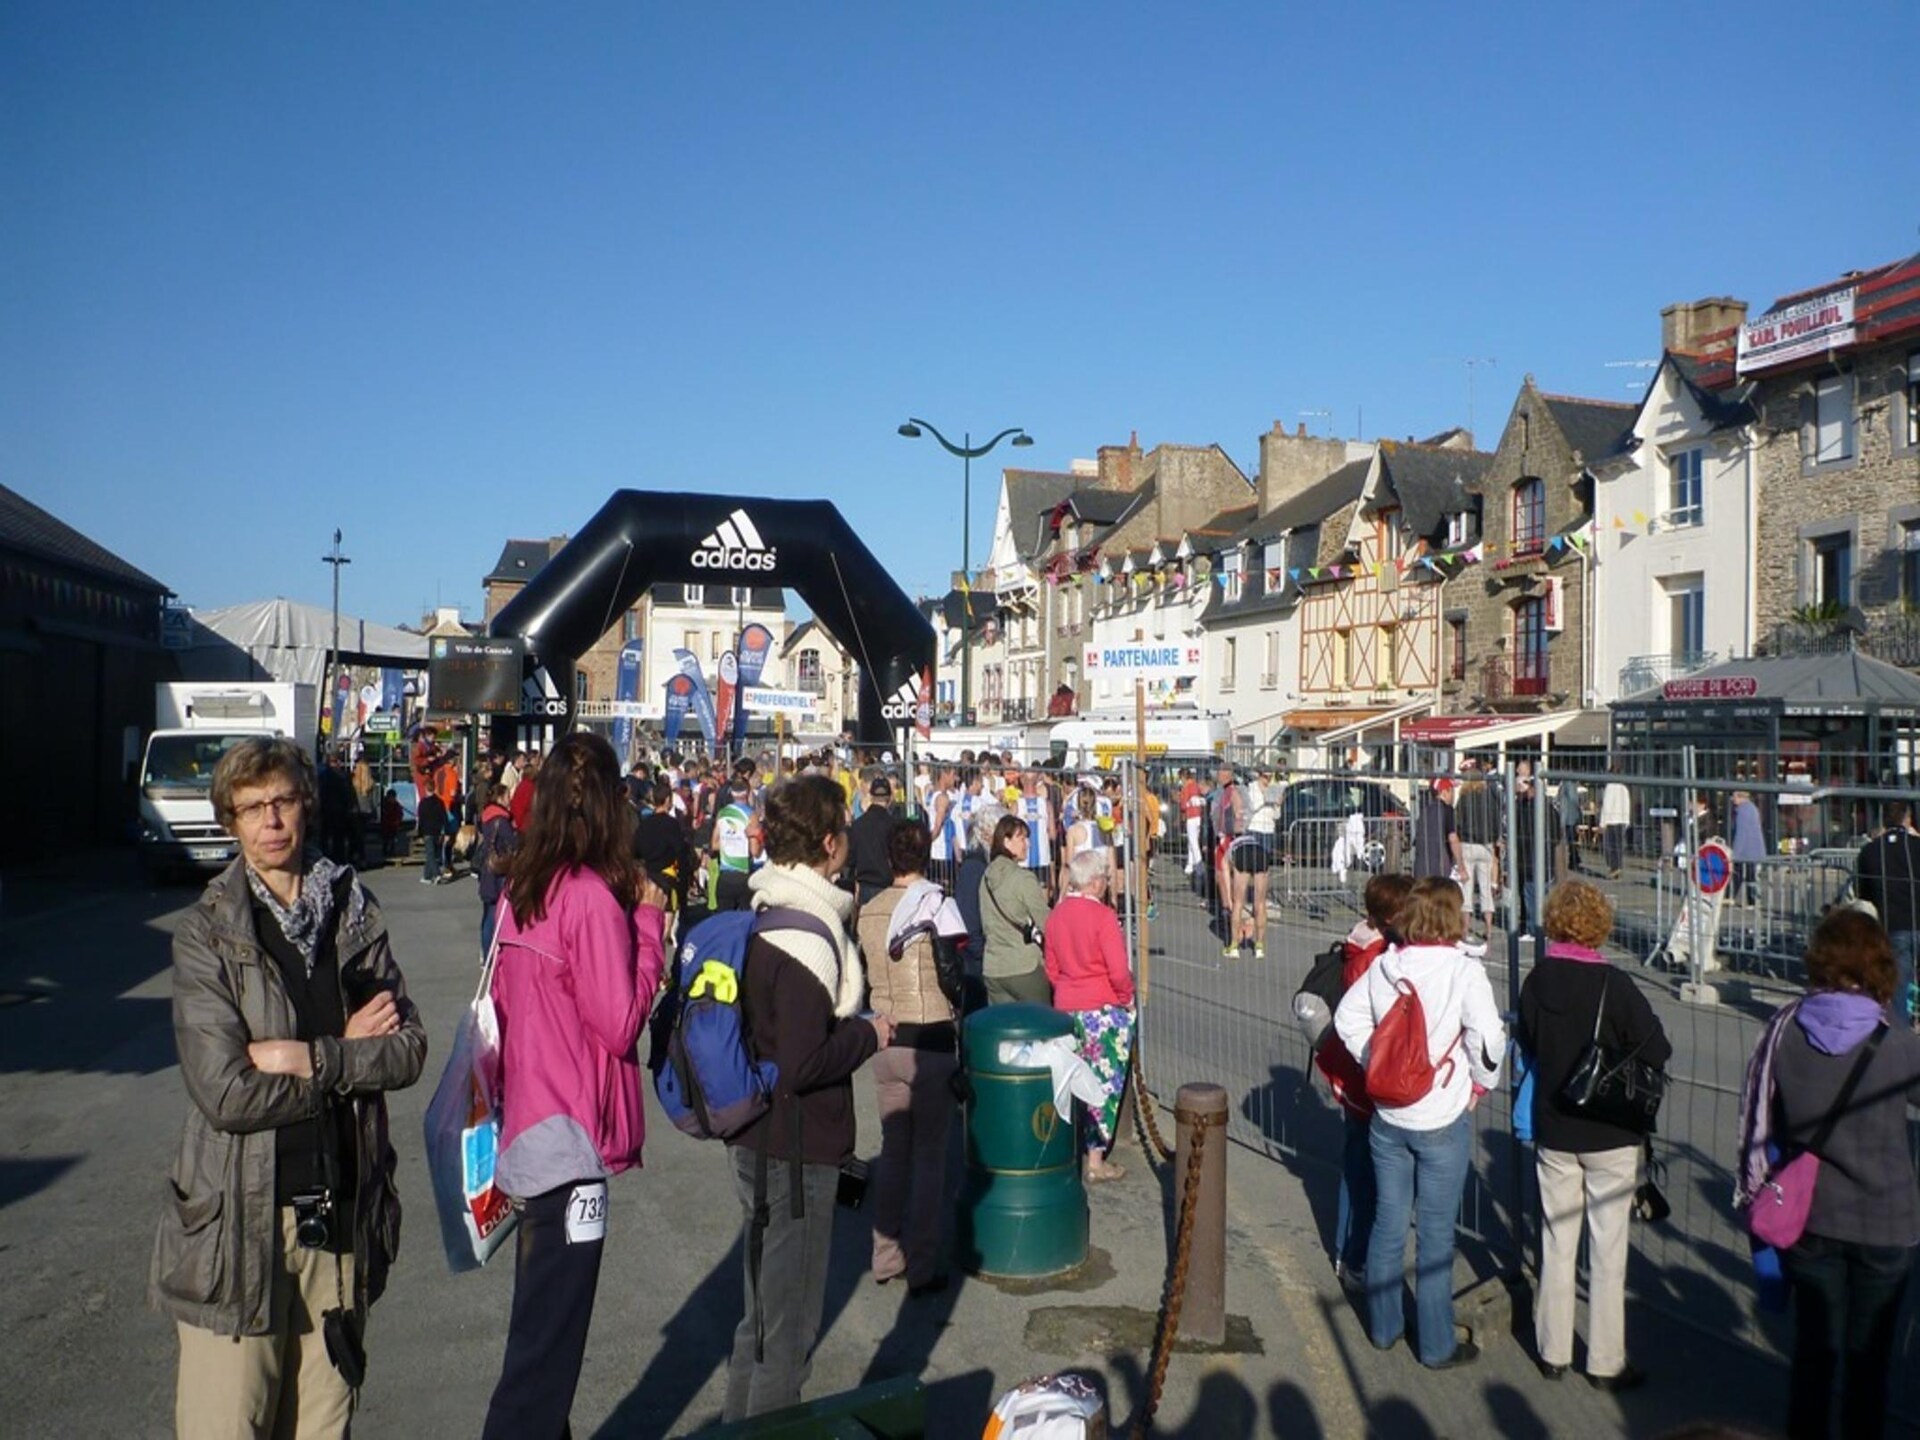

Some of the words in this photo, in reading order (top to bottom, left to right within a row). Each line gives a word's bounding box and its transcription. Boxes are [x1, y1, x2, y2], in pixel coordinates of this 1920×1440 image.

[691, 546, 776, 571] adidas
[455, 645, 473, 654] Ville
[474, 645, 482, 653] de
[1103, 648, 1179, 667] PARTENAIRE
[520, 696, 567, 716] didas
